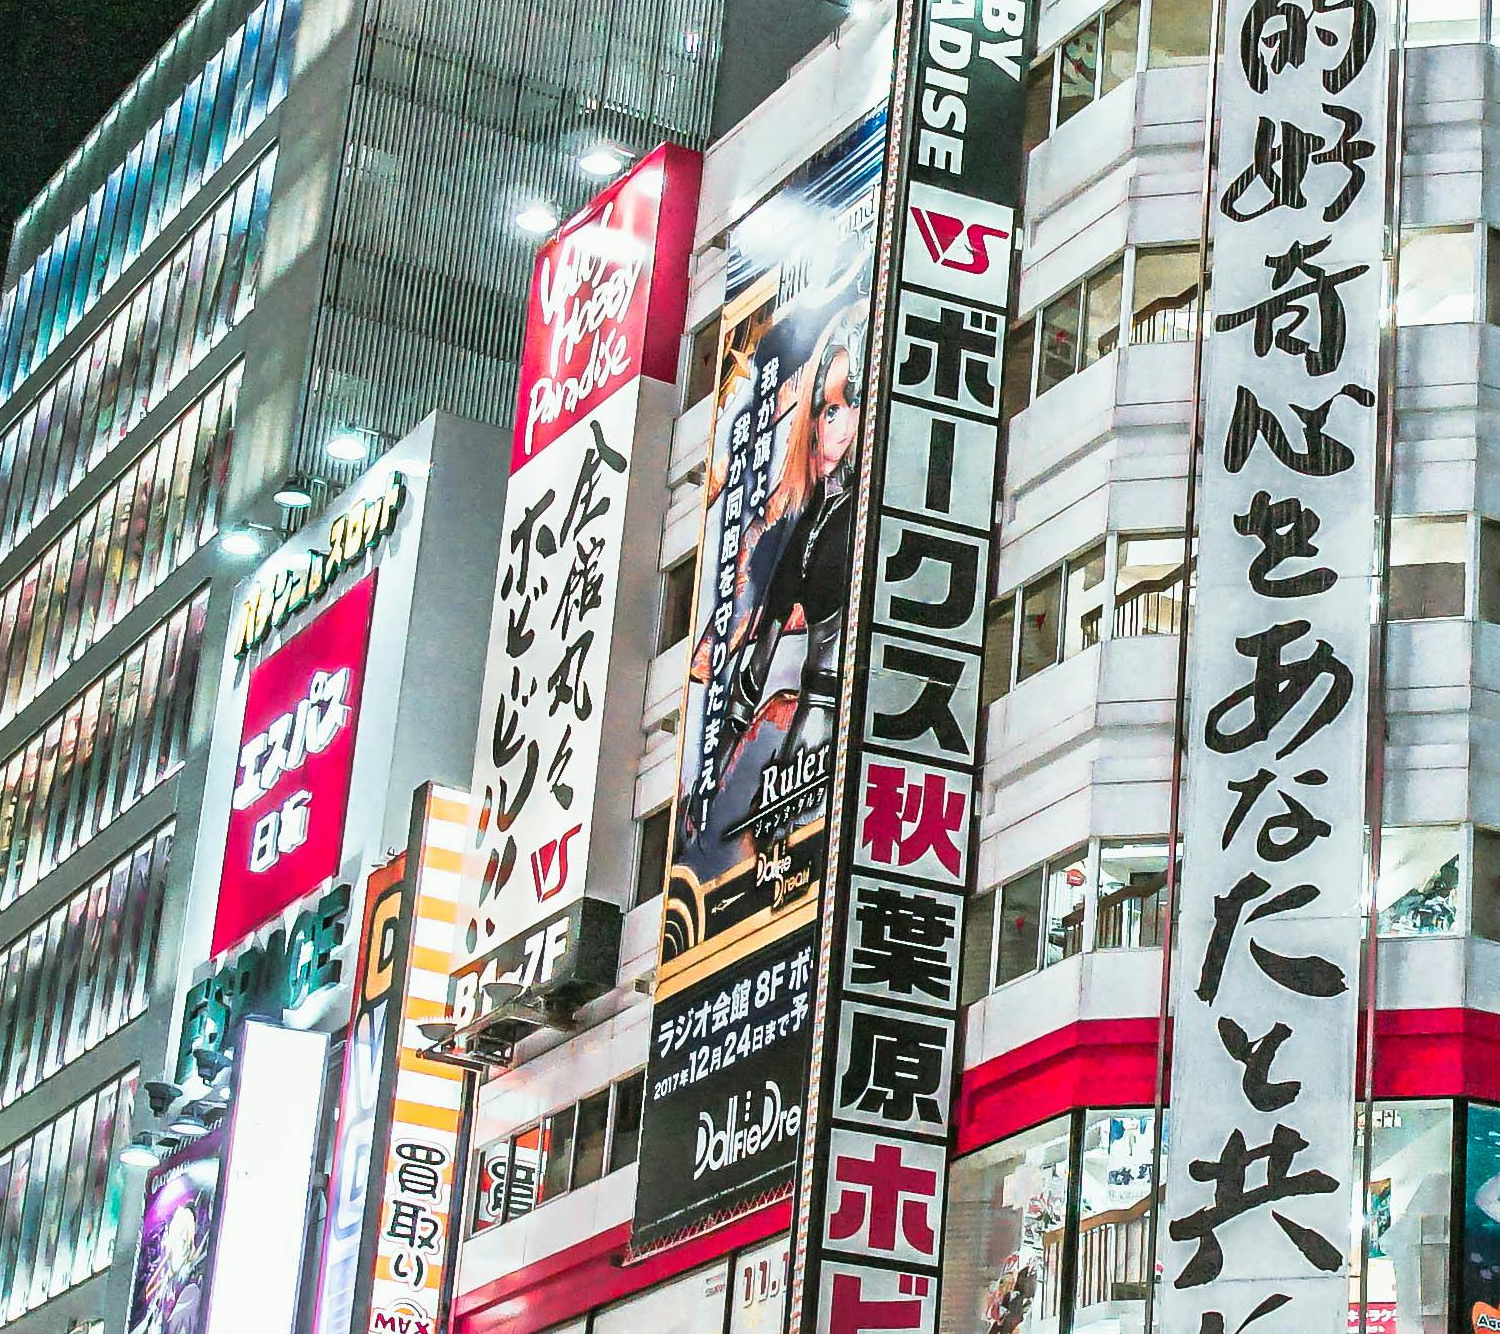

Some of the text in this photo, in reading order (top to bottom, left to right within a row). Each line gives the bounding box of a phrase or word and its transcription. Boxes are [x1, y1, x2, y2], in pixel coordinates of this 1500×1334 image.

[522, 335, 633, 454] Paradise
[235, 669, 353, 812] エスパス
[758, 738, 831, 811] Ruler
[658, 972, 788, 1058] ラジオ会館 8F
